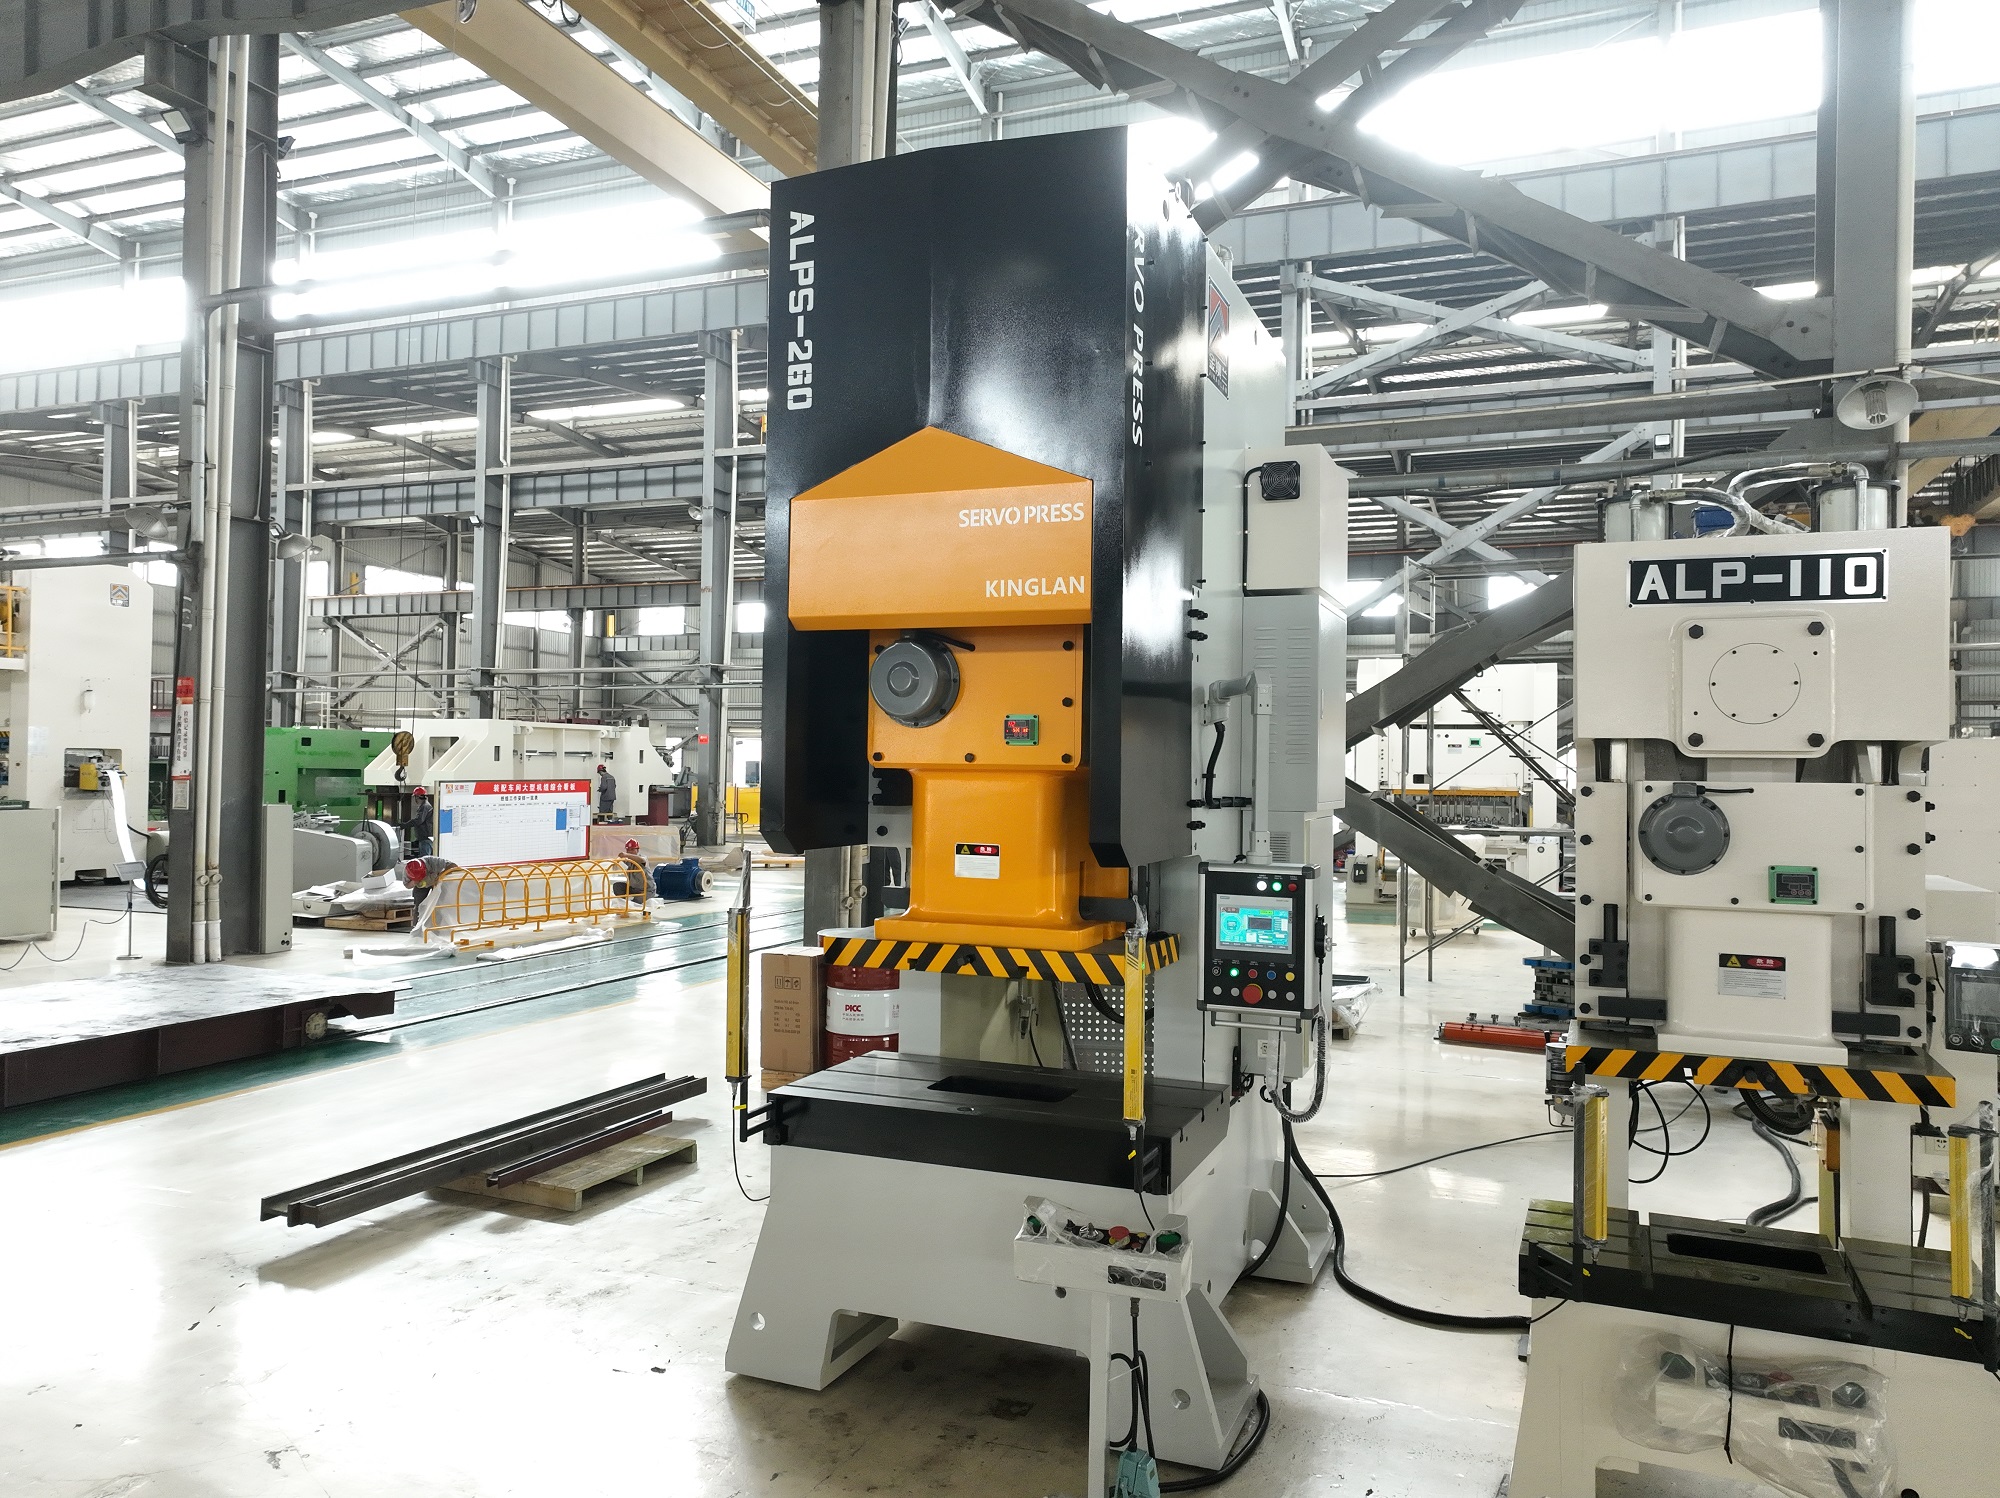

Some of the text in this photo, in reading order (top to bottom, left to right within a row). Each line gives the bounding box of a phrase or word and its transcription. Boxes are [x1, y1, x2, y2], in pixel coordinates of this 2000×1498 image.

[787, 210, 815, 411] ALPS-260
[1132, 226, 1145, 447] RVO PRESS
[958, 502, 1085, 528] SERVO PRESS
[985, 575, 1085, 598] KINGLAN
[1636, 556, 1878, 601] ALP-110
[845, 1004, 862, 1012] PICC
